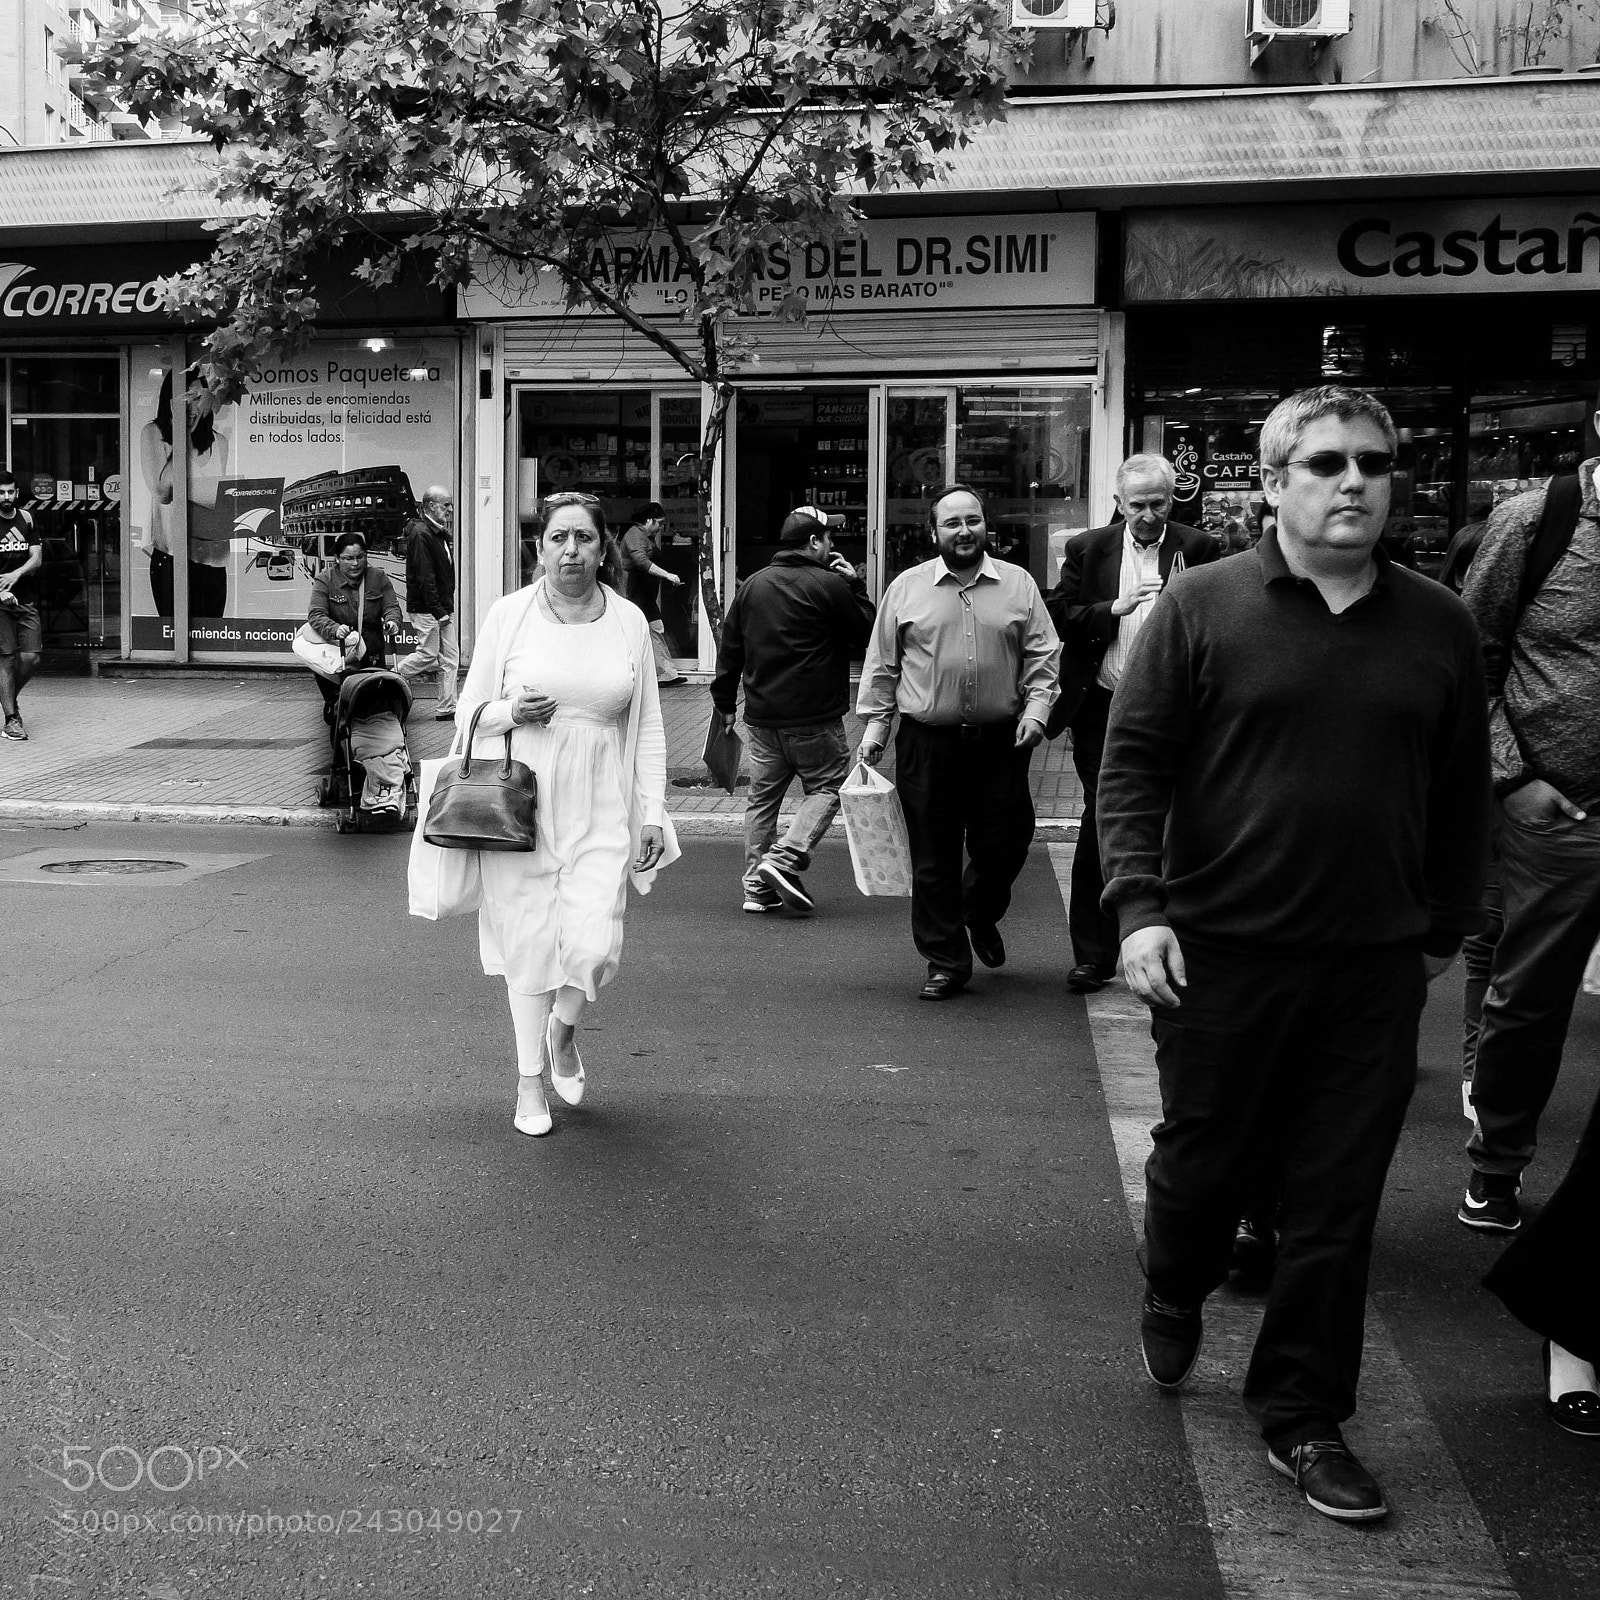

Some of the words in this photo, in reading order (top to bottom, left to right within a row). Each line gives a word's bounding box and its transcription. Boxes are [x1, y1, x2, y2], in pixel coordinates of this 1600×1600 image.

[805, 238, 882, 280] DEL
[3, 280, 181, 317] CORREO
[759, 285, 810, 302] PEO
[815, 284, 855, 300] MAS
[251, 362, 319, 383] Somos
[250, 392, 302, 406] Millones
[306, 391, 322, 405] de
[326, 391, 411, 405] encomiendas
[250, 410, 325, 426] distribuidas,
[330, 410, 342, 424] la
[347, 409, 401, 424] felicidad
[406, 410, 432, 424] está
[250, 432, 264, 443] en
[269, 429, 303, 443] todos
[307, 429, 345, 443] lados.
[1212, 452, 1253, 461] Castaño
[1203, 461, 1260, 478] CAFÉ
[162, 624, 242, 640] Enmiendas
[245, 626, 298, 641] nacional
